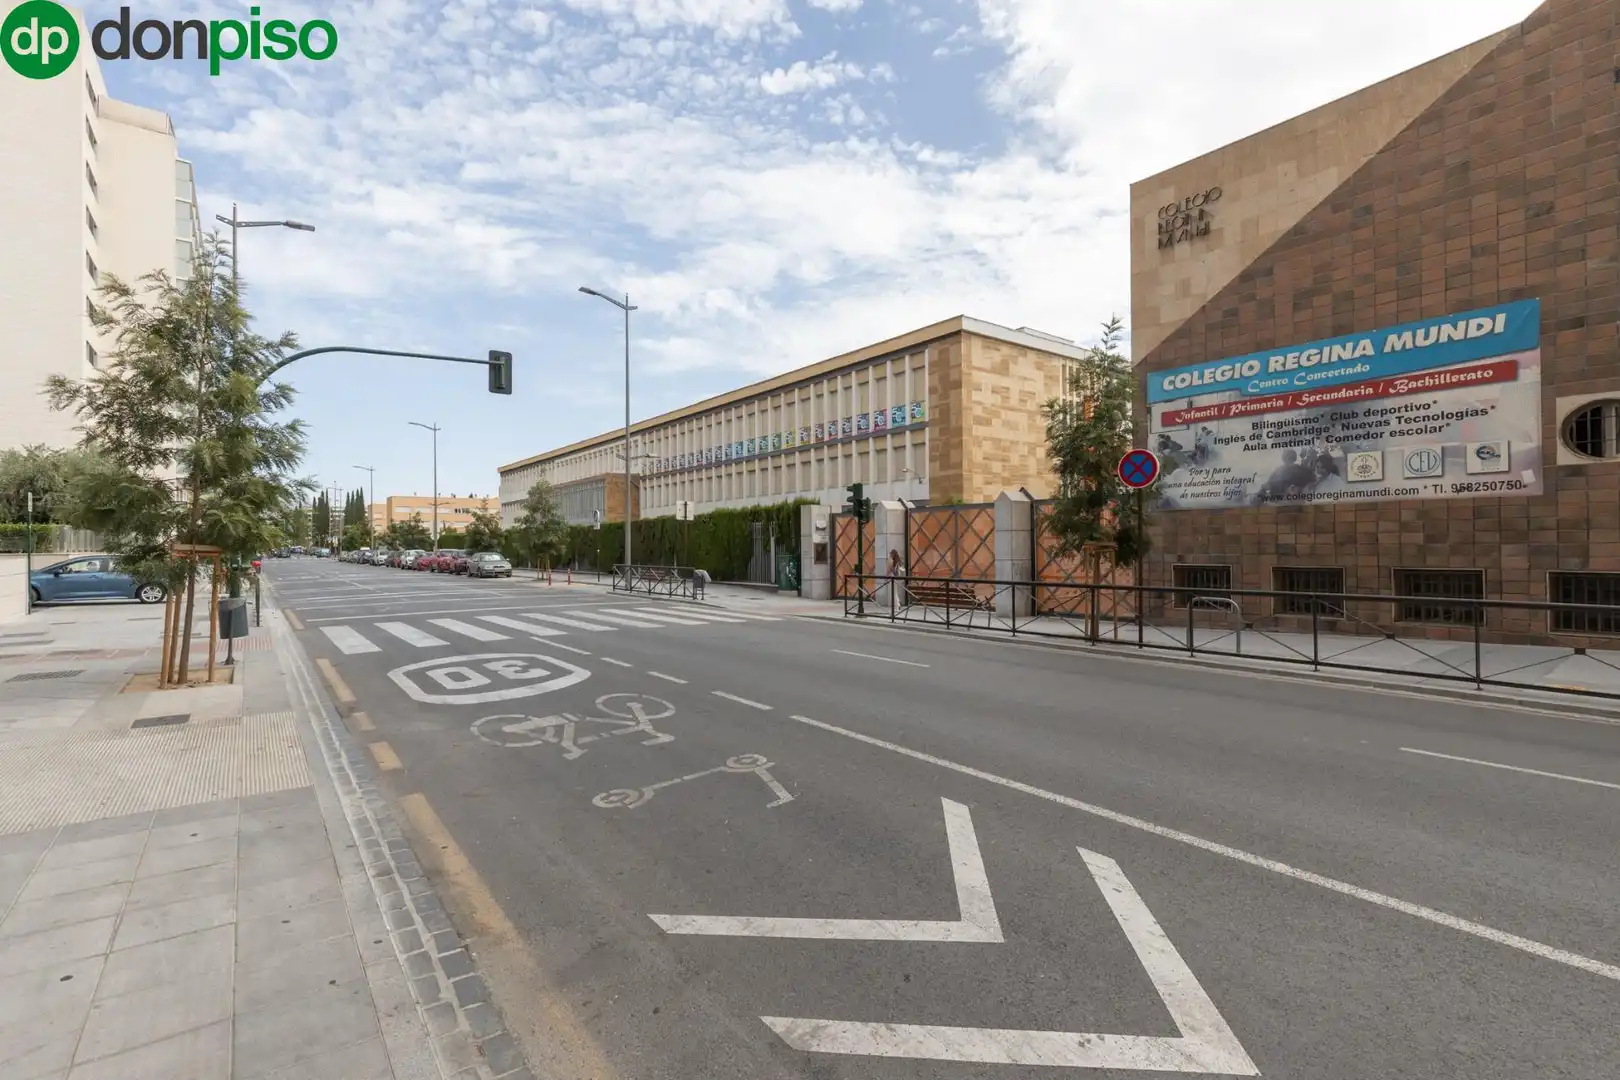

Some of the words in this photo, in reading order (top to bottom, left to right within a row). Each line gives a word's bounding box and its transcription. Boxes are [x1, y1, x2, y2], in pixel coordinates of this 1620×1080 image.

[1158, 186, 1222, 219] COLEGIO
[1162, 359, 1261, 391] COLEGIO
[1267, 338, 1376, 373] REGINA
[1383, 313, 1507, 353] MUNDI
[1247, 378, 1289, 393] Centro
[1294, 363, 1371, 386] Concertado
[1229, 399, 1285, 416] Primaria
[1296, 385, 1374, 406] Secundaria
[1388, 369, 1494, 394] Bachillerato
[1330, 411, 1359, 421] Club
[1214, 434, 1246, 445] Inglés
[1250, 430, 1263, 441] de
[1341, 417, 1391, 432] Nuevas
[1243, 440, 1268, 452] Aula
[1325, 431, 1385, 444] Comedor
[1184, 477, 1221, 488] educación
[1223, 472, 1257, 487] integral
[1212, 466, 1232, 478] para
[1180, 489, 1189, 499] de
[1190, 491, 1221, 499] nuestros
[1223, 486, 1242, 500] hijos
